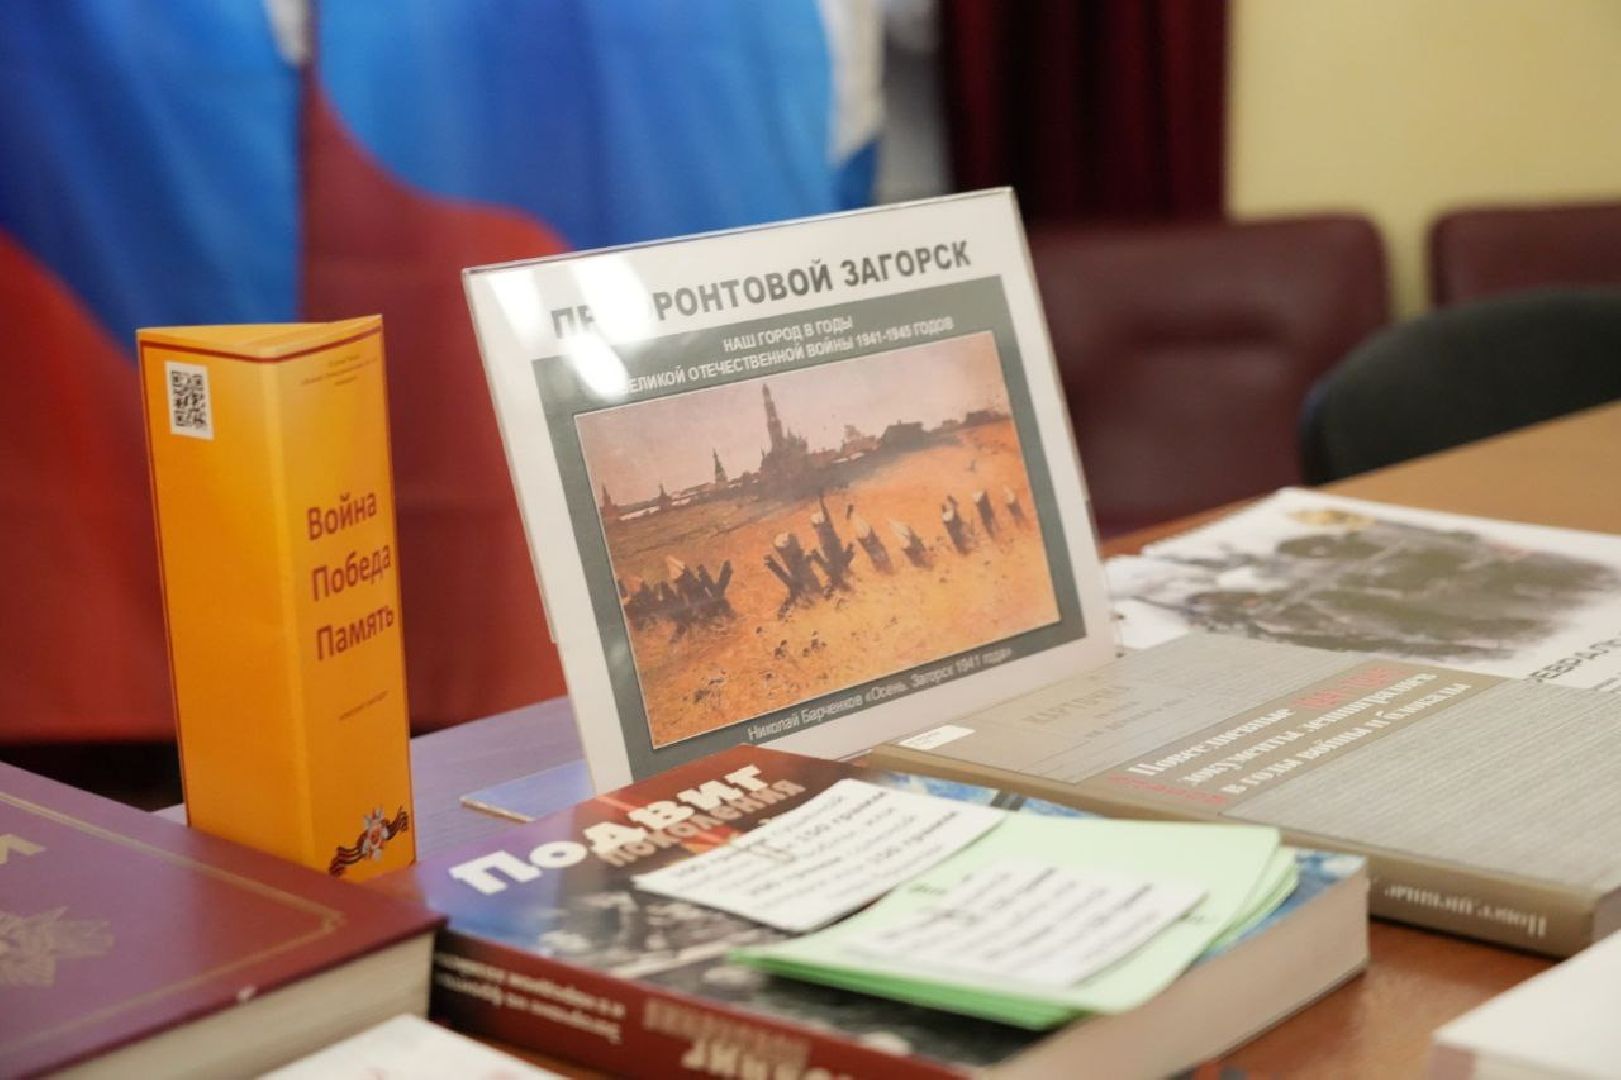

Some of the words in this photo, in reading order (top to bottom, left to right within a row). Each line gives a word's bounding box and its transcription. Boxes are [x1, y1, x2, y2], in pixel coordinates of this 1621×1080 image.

[550, 258, 833, 340] ПРРОНТОВОЙ
[840, 240, 972, 287] ЗАГОРСК
[627, 364, 687, 393] ЕЛИКОЙ
[689, 342, 805, 381] ОТЕЧЕСТВЕННОЙ
[808, 336, 854, 358] ВОЙНЫ
[856, 323, 911, 347] 1941-1945
[912, 316, 955, 338] ГОДОВ
[723, 334, 757, 352] НАШ
[757, 323, 803, 347] ГОРОД
[803, 321, 815, 337] В
[815, 315, 853, 335] ГОДЫ
[306, 492, 378, 541] Война
[312, 545, 392, 602] Победа
[316, 605, 394, 661] Память
